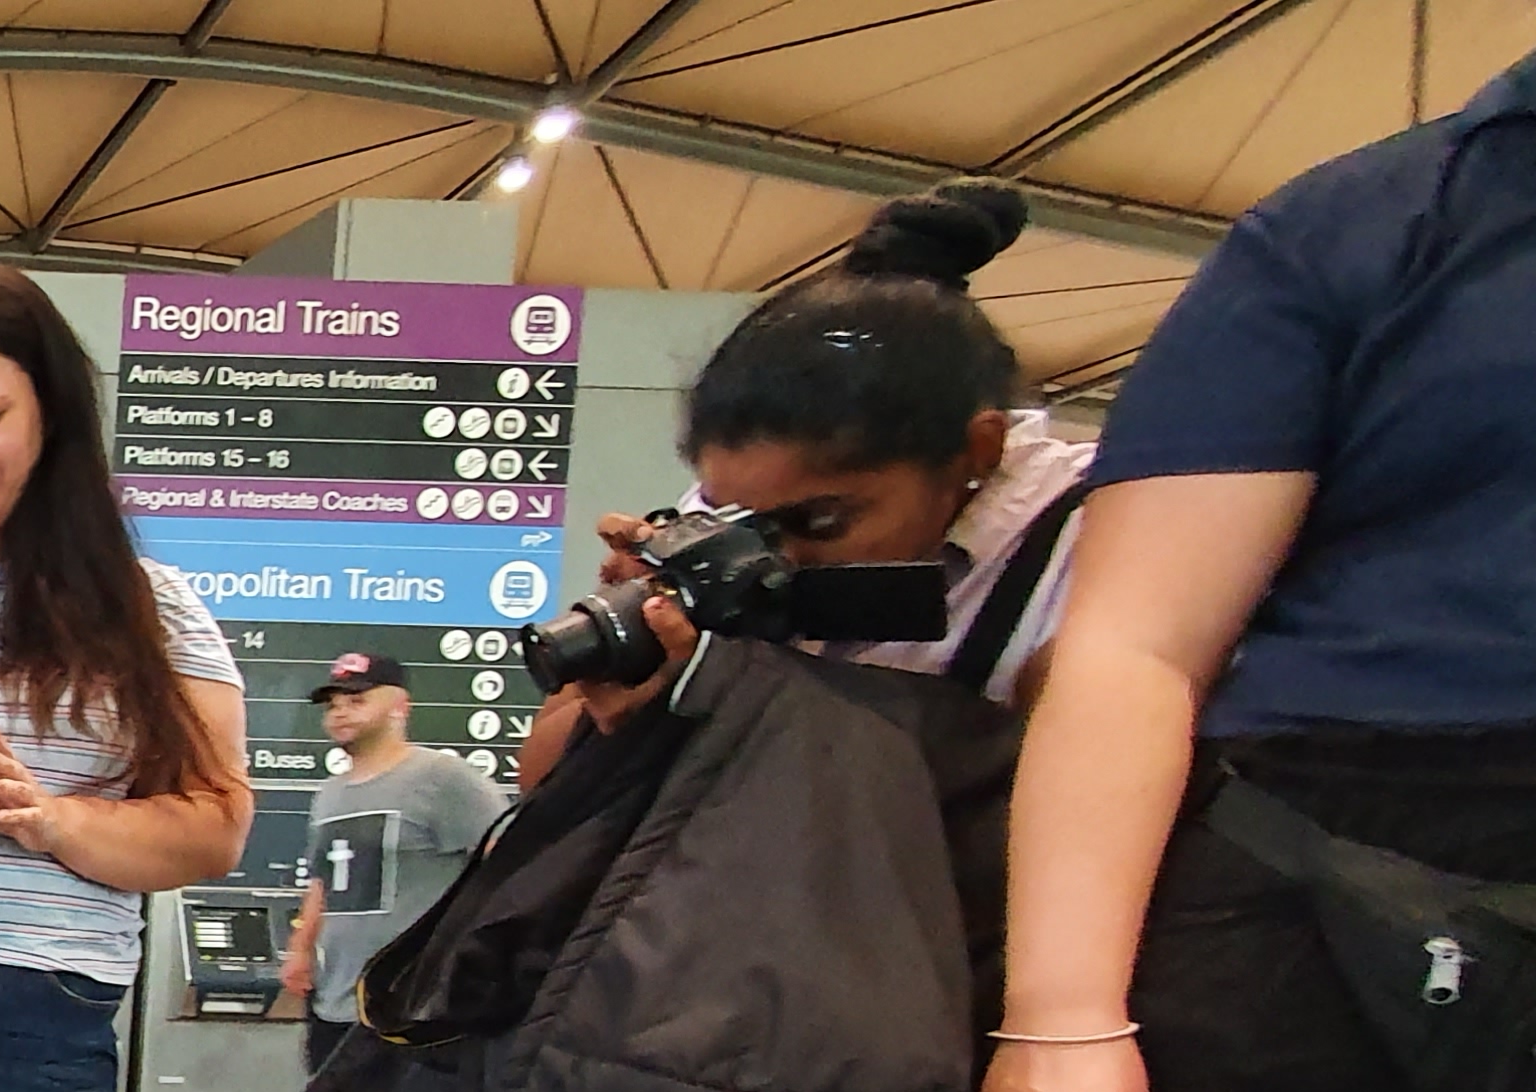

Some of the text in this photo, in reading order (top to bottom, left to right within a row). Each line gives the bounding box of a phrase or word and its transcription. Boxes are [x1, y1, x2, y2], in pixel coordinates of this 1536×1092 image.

[131, 296, 400, 340] Regional Trains
[127, 364, 200, 385] Arrivals
[216, 366, 325, 391] Departures
[328, 369, 439, 392] Information
[127, 404, 220, 427] Platforms
[224, 407, 236, 427] 1
[257, 408, 274, 428] 8
[124, 445, 216, 467] Platforms
[220, 448, 244, 467] 15
[266, 449, 290, 469] 16
[121, 486, 408, 512] Regional & Interstate Coaches
[342, 567, 446, 603] Trains
[241, 631, 266, 649] 14
[254, 749, 316, 770] Buses
